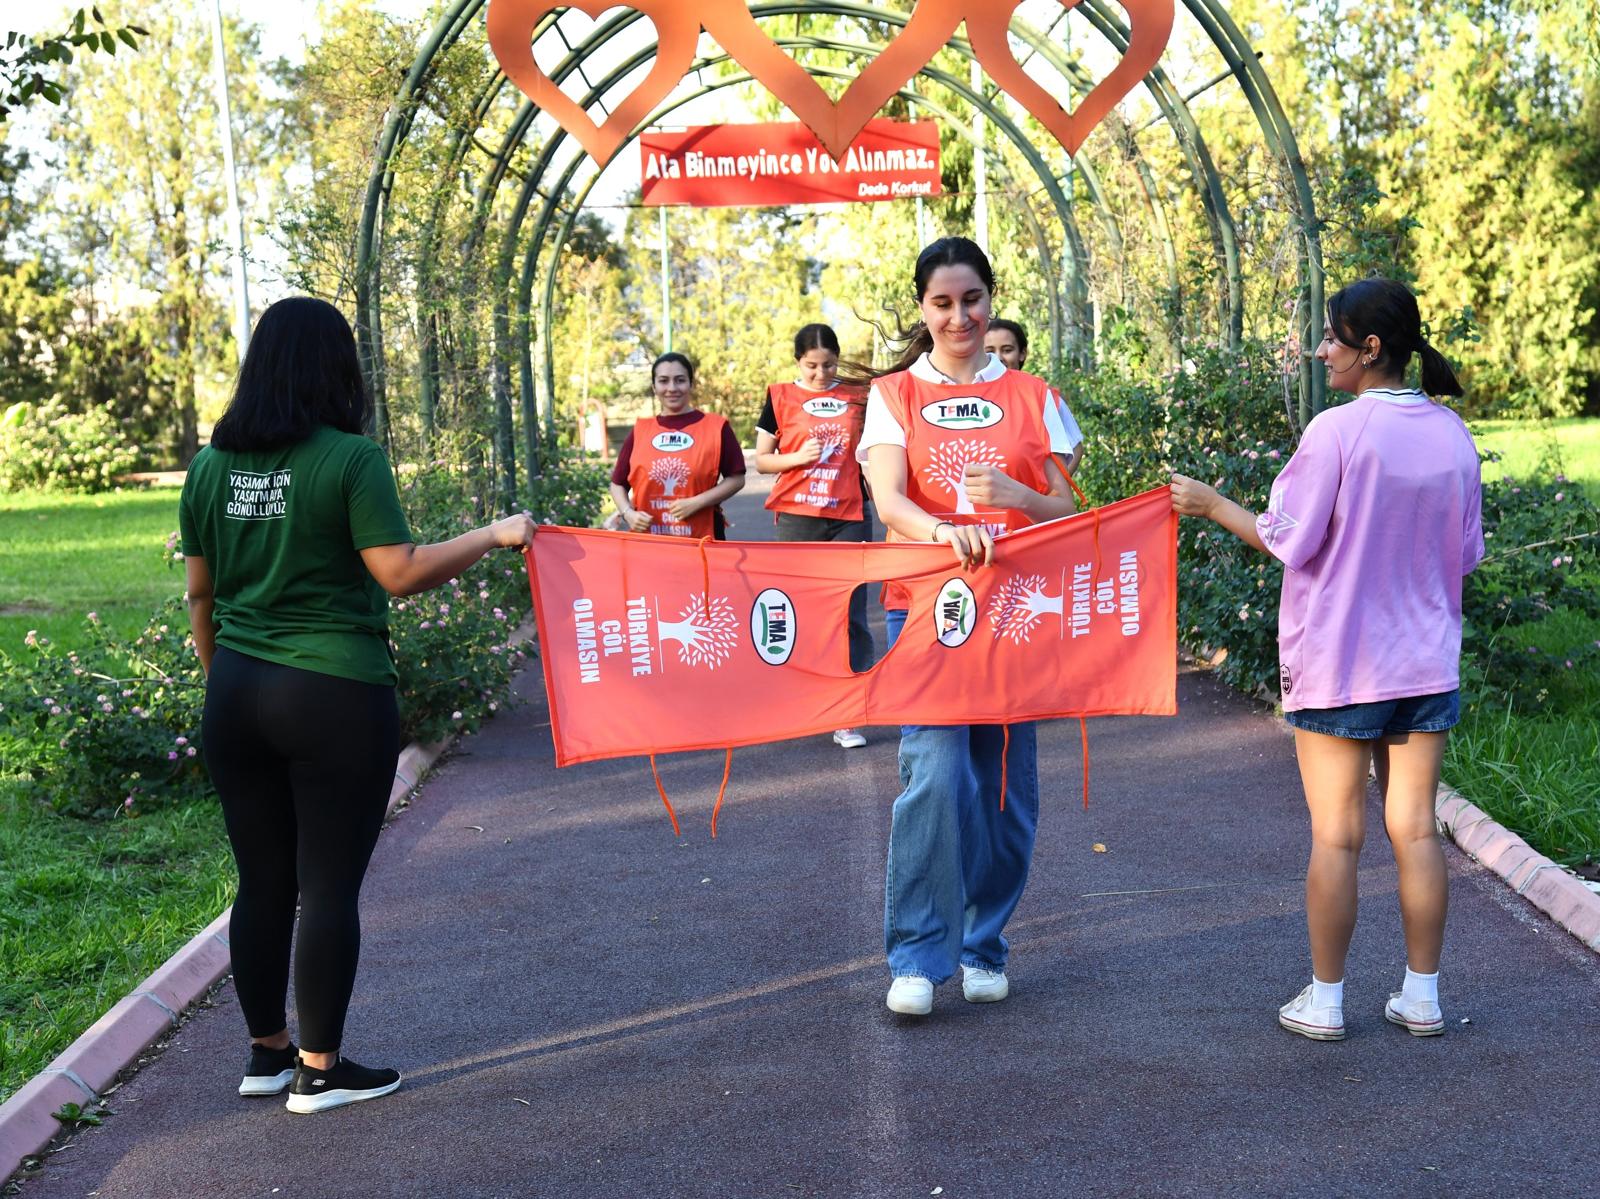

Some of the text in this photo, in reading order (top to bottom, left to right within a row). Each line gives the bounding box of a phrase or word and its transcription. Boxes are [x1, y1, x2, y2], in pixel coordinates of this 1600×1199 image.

[645, 152, 681, 180] Ata
[684, 148, 803, 181] Binmeyince
[845, 145, 935, 173] Alınmaz.
[858, 181, 932, 196] Dede Korkut
[938, 403, 980, 418] TEMA
[273, 471, 291, 488] İÇİN
[1067, 561, 1092, 639] TÜRKİYE
[1092, 577, 1118, 615] ÇÖL
[1119, 550, 1140, 637] OLMASIN
[573, 598, 600, 684] OLMASIN
[598, 619, 627, 657] ÇÖL
[625, 596, 655, 677] TÜRKİYE
[768, 603, 787, 643] TEMA
